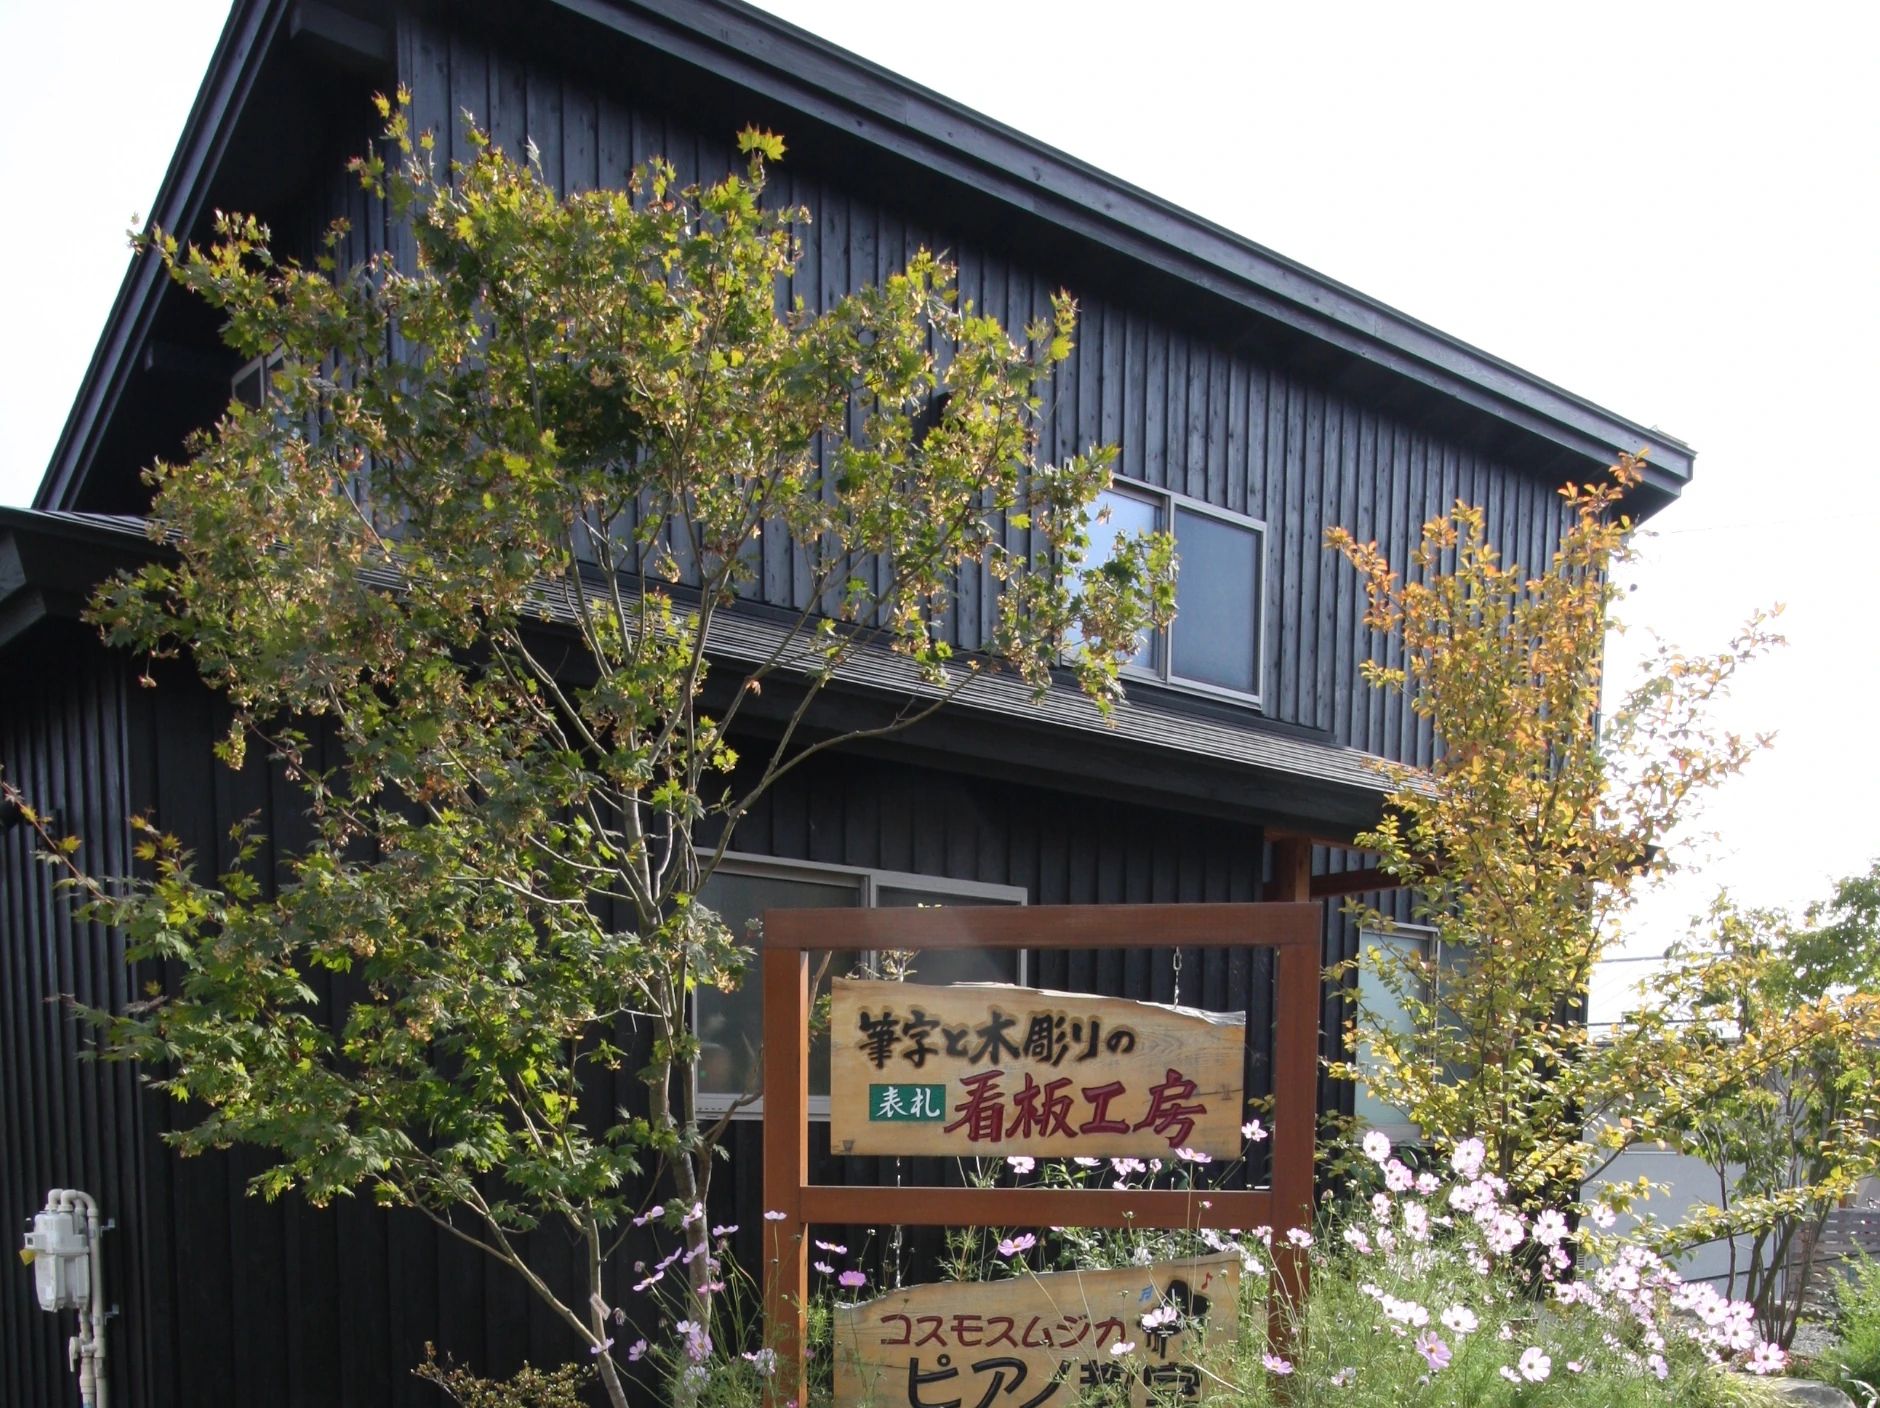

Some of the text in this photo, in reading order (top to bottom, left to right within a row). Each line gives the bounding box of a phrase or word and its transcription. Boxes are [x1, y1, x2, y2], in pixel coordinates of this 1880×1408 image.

[858, 1010, 1136, 1069] 筆字と木彫りの
[875, 1086, 941, 1118] 表札
[943, 1068, 1208, 1148] 看板工房
[880, 1313, 1126, 1348] コスモスムジカ
